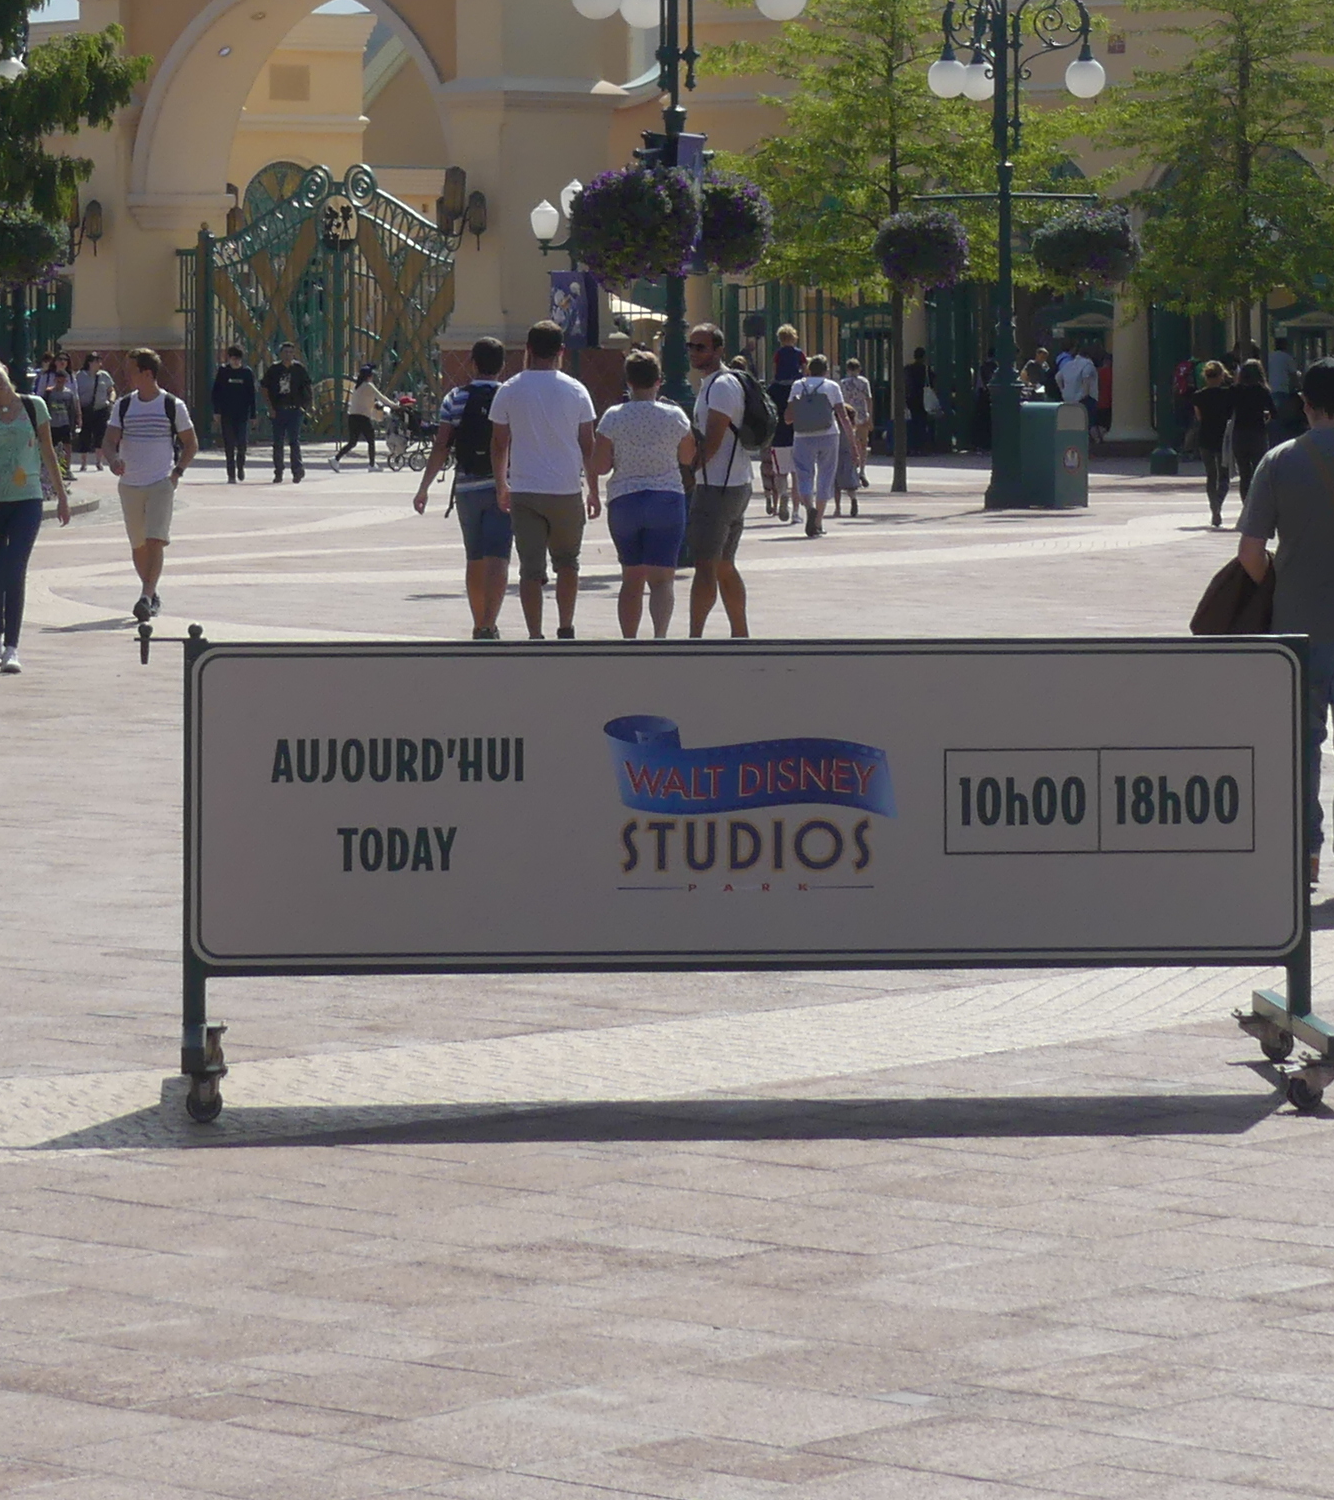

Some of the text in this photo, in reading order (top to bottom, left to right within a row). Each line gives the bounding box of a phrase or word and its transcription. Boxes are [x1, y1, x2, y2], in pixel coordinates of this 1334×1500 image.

[271, 737, 524, 783] AUJOURD'HUI
[623, 756, 877, 800] WALT DISNEY
[959, 774, 1239, 826] 10h00 18h00
[336, 826, 457, 872] TODAY
[622, 816, 872, 873] STUDIOS
[687, 882, 809, 893] PARK
